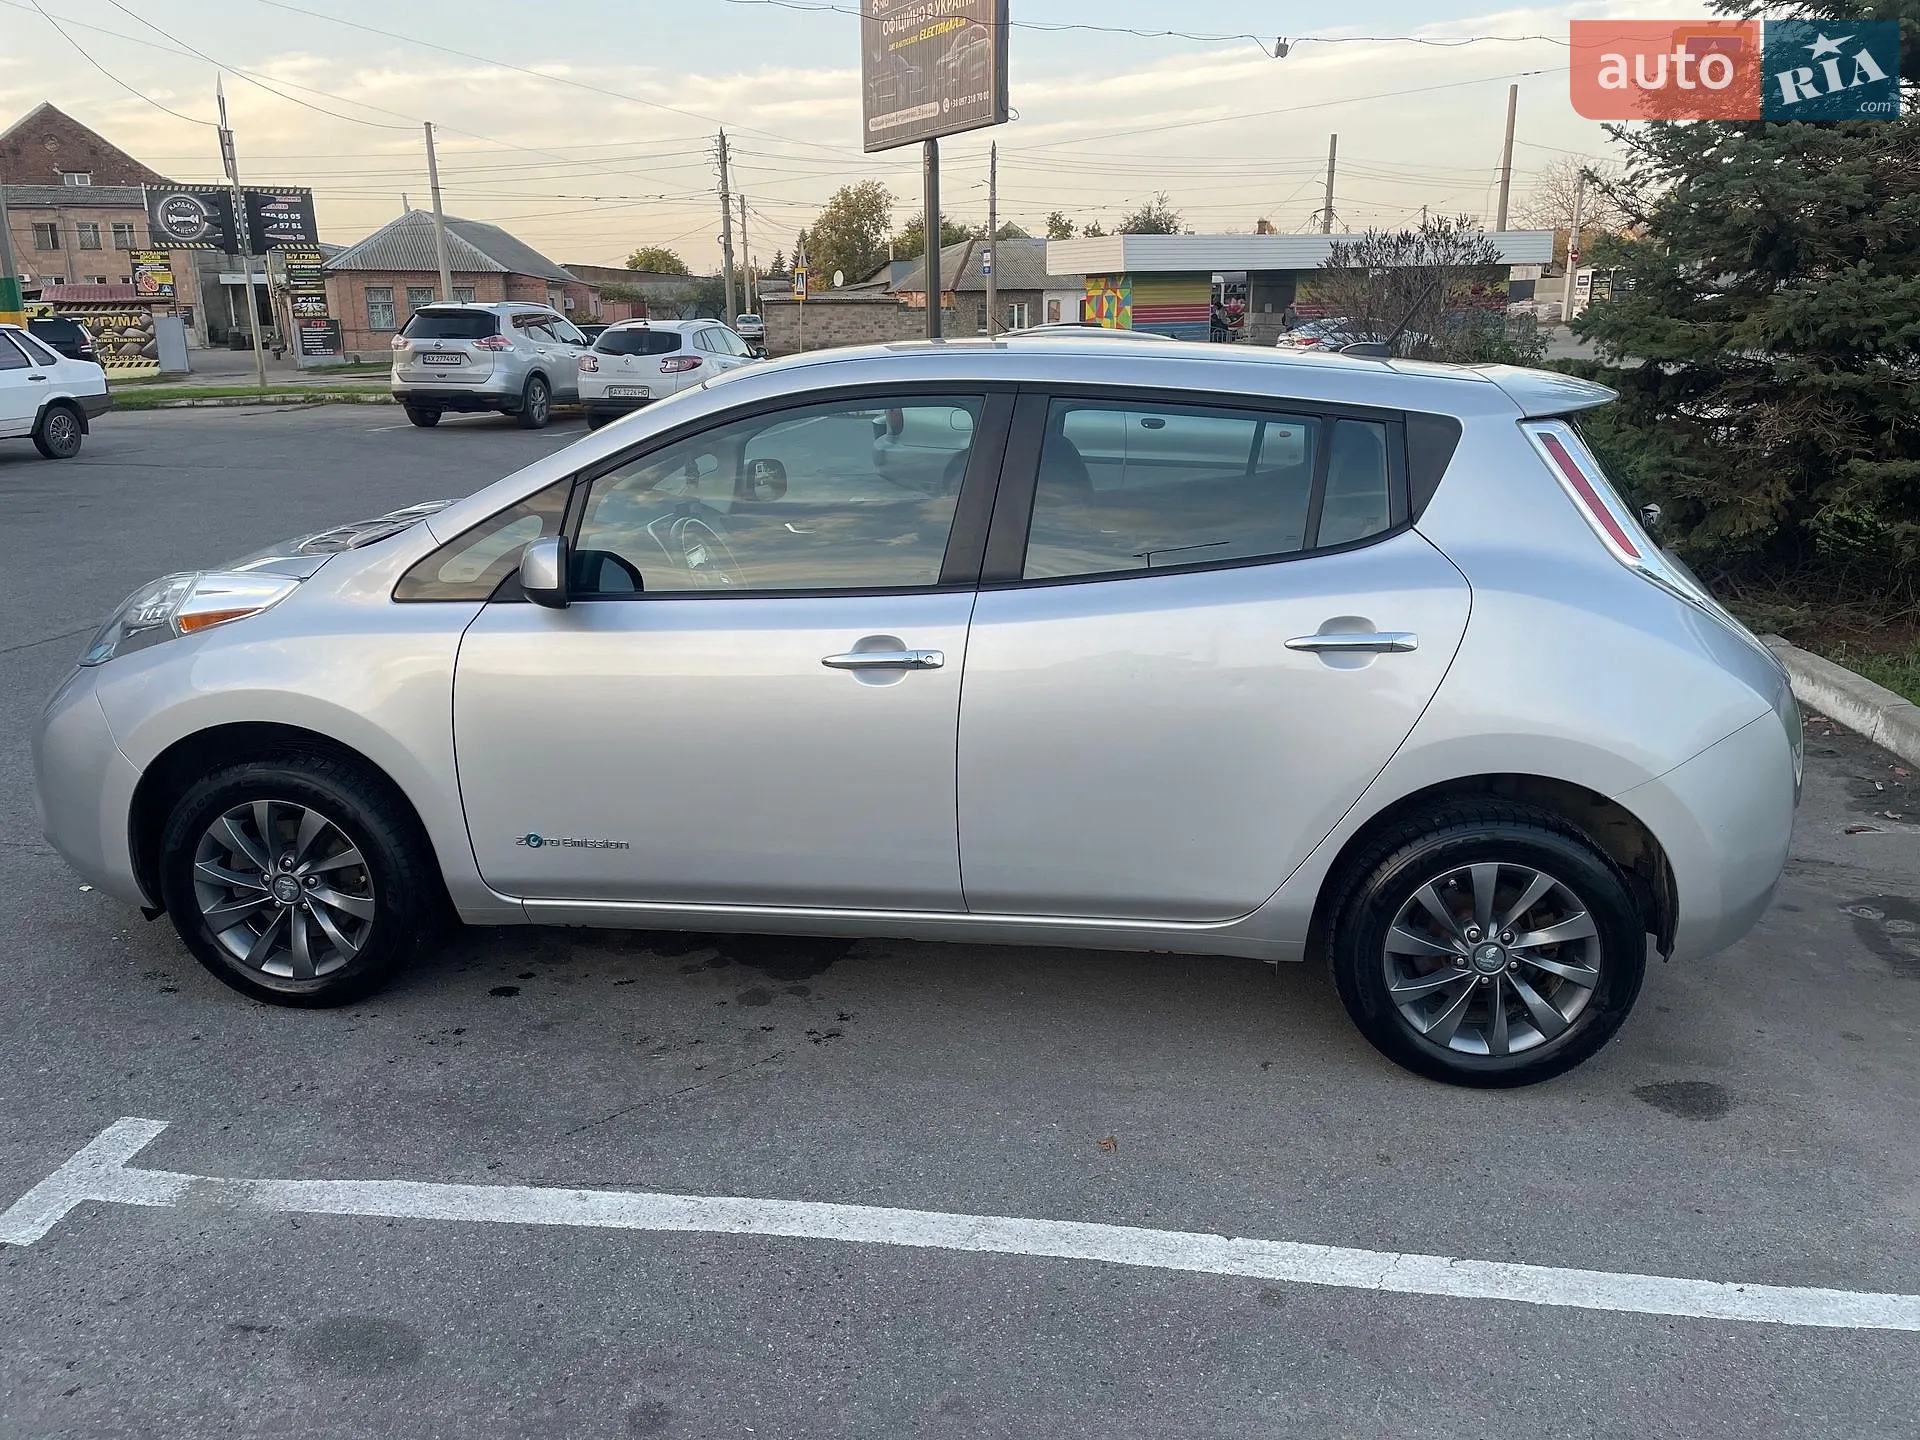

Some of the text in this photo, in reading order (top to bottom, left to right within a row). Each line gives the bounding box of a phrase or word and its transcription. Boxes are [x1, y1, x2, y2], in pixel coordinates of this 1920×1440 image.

[168, 201, 196, 211] КАРДАН
[100, 316, 141, 327] ГУМА
[562, 837, 630, 849] Emission
